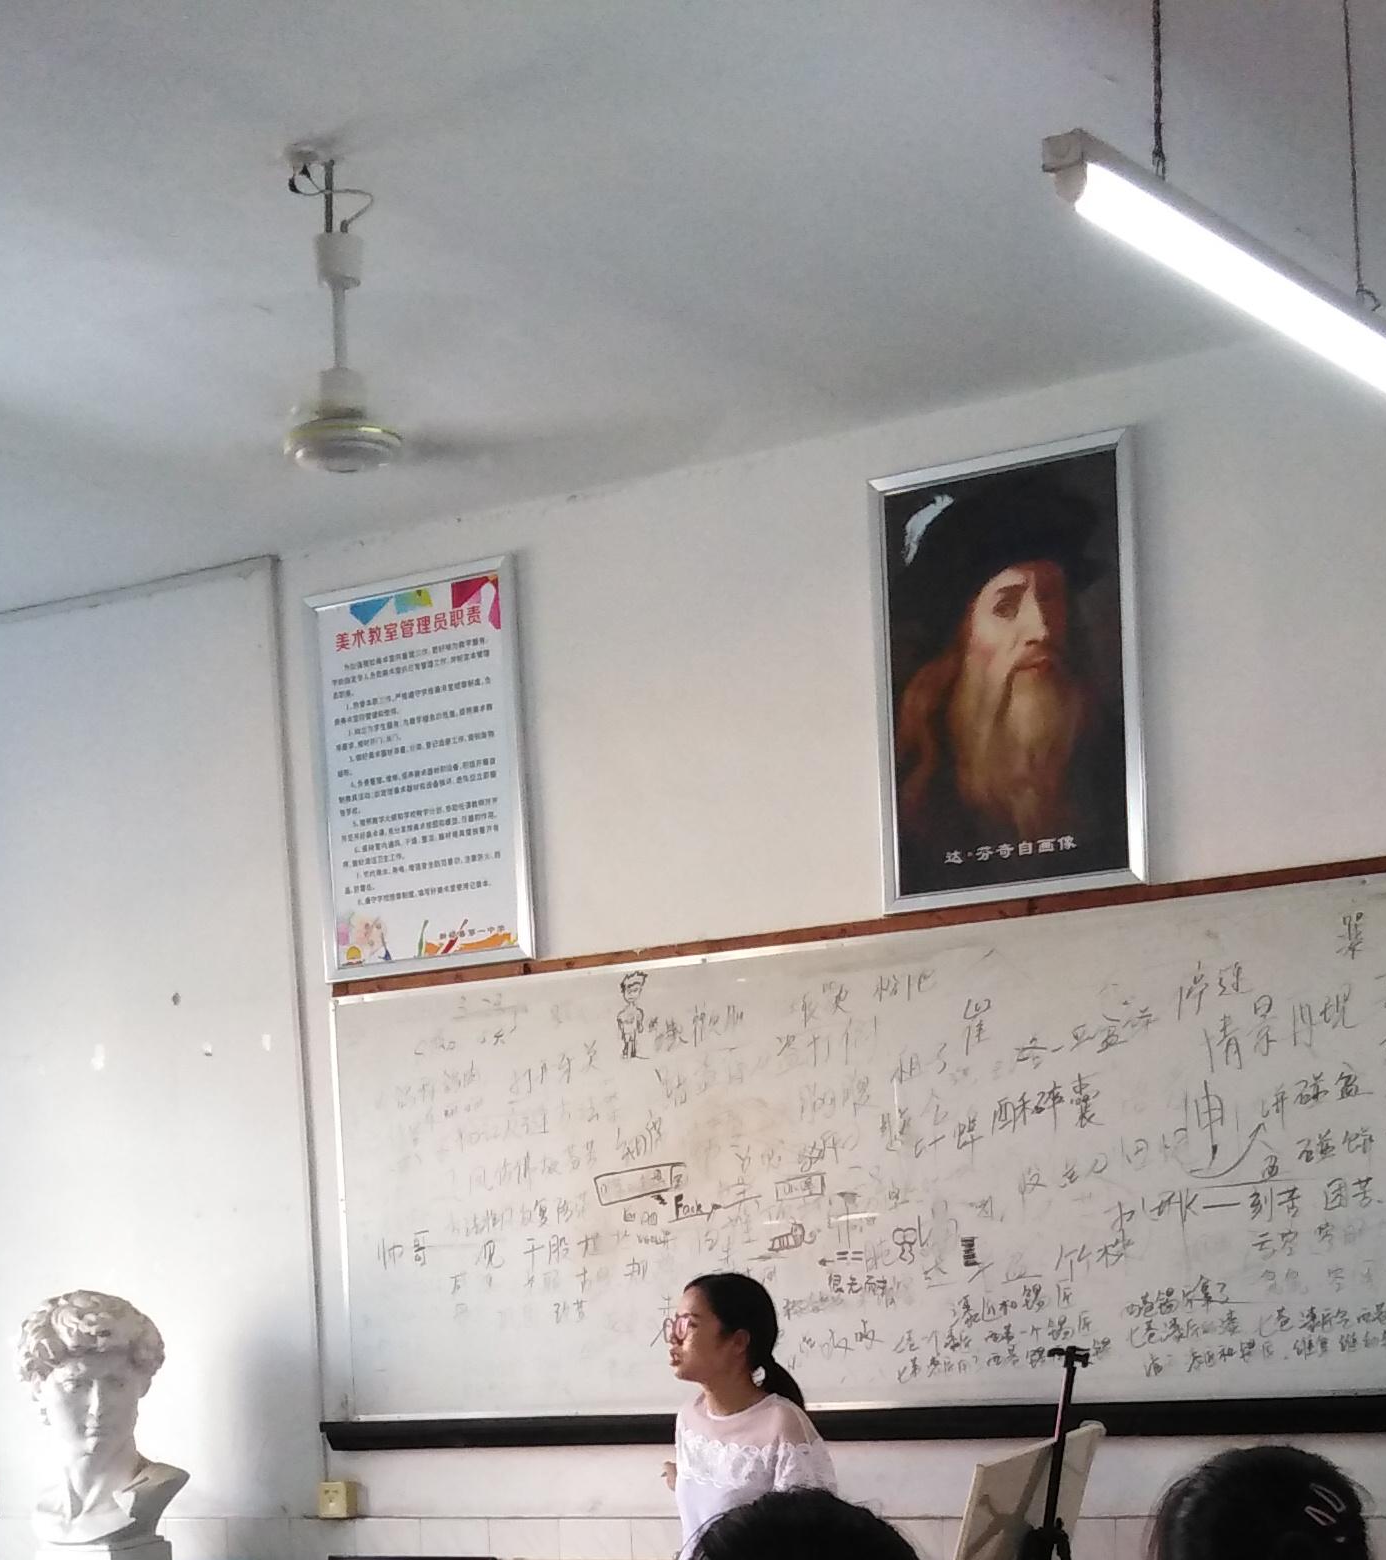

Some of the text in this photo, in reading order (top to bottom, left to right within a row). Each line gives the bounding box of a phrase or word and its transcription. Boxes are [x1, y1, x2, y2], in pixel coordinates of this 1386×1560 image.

[334, 605, 482, 652] 美术教室管理员职责
[944, 835, 1078, 865] 达·芬奇自画像
